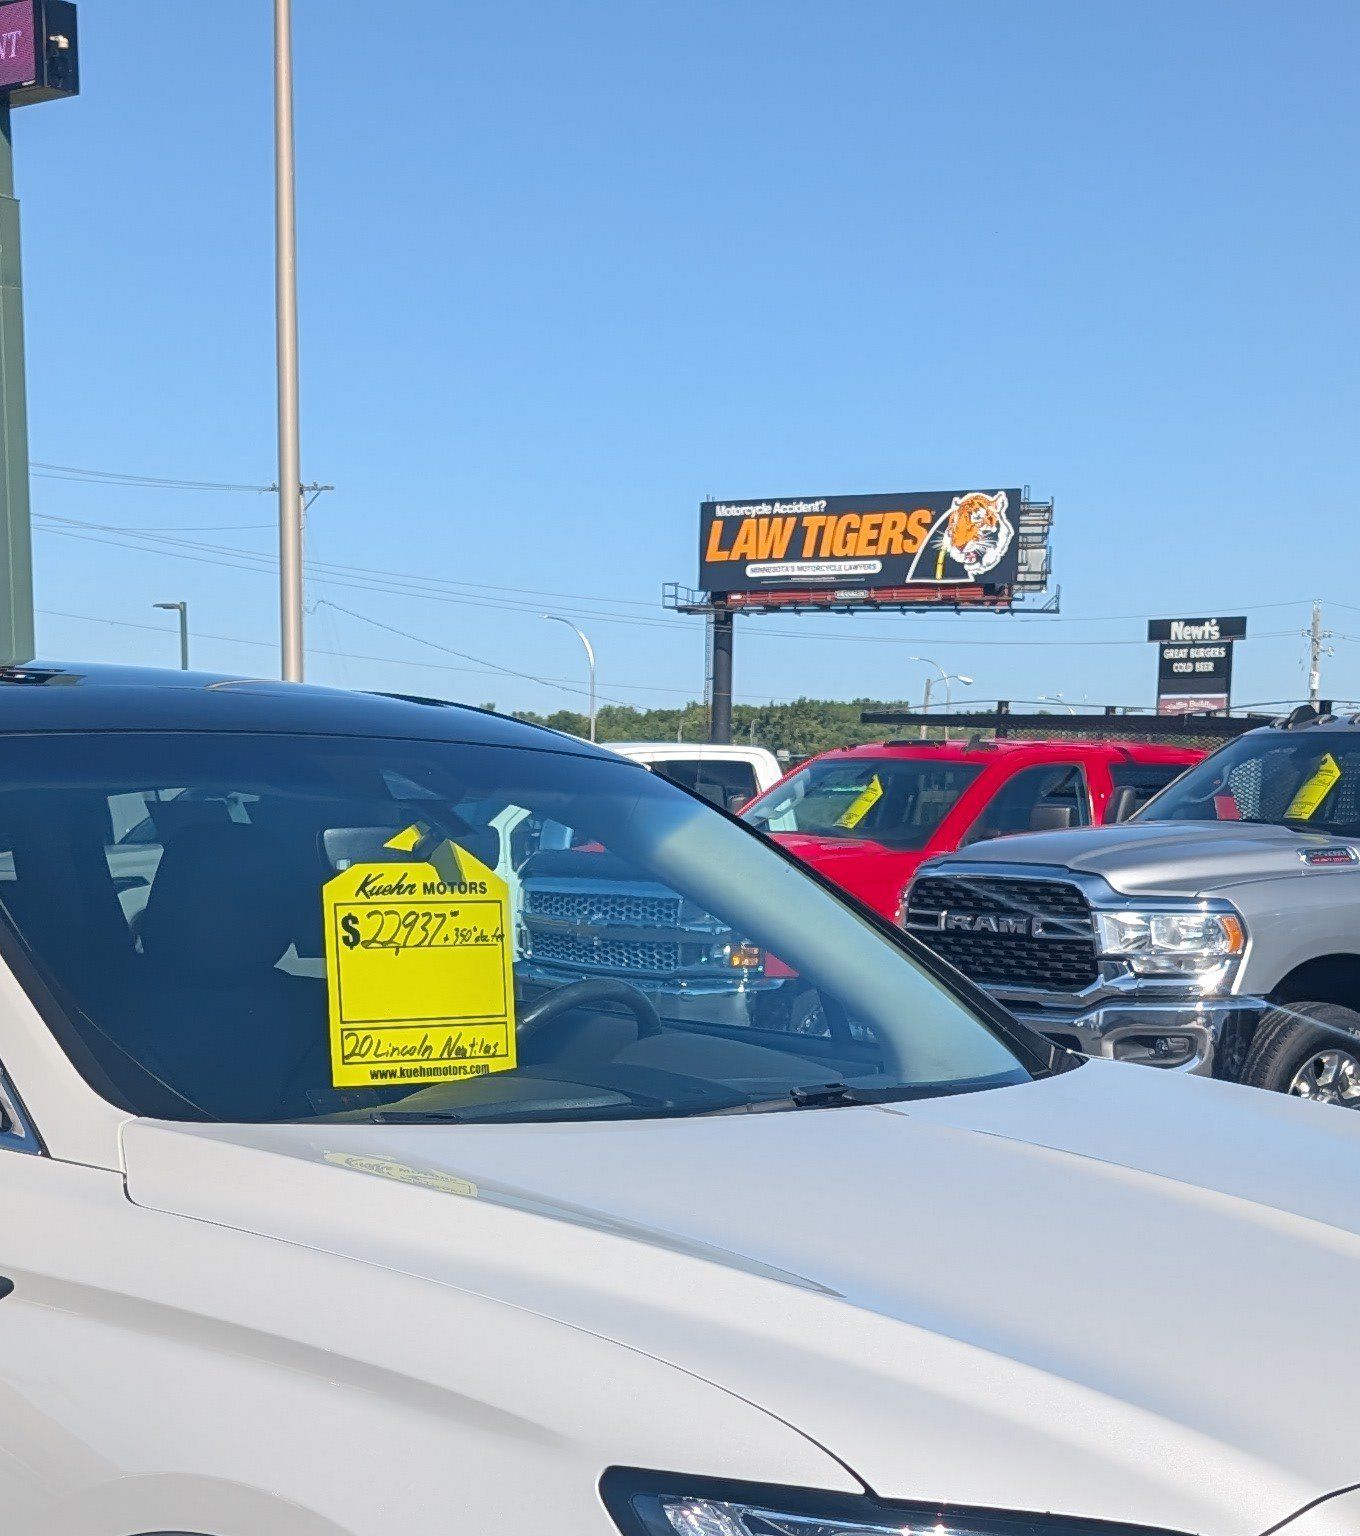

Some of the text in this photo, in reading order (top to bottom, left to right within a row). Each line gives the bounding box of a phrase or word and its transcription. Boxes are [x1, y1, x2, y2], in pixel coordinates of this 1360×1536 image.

[715, 499, 827, 518] Motorcycle Accident?
[705, 509, 933, 562] LAW TIGERS
[1170, 618, 1220, 640] Newt's
[1163, 647, 1226, 659] GREAT BURGERS
[1172, 662, 1214, 673] COLD BEER
[355, 872, 488, 899] Kuehn MOTORS
[945, 914, 1031, 935] RAM
[374, 1033, 434, 1059] Lincoln
[369, 1064, 490, 1081] www.kuehnmotors.com
